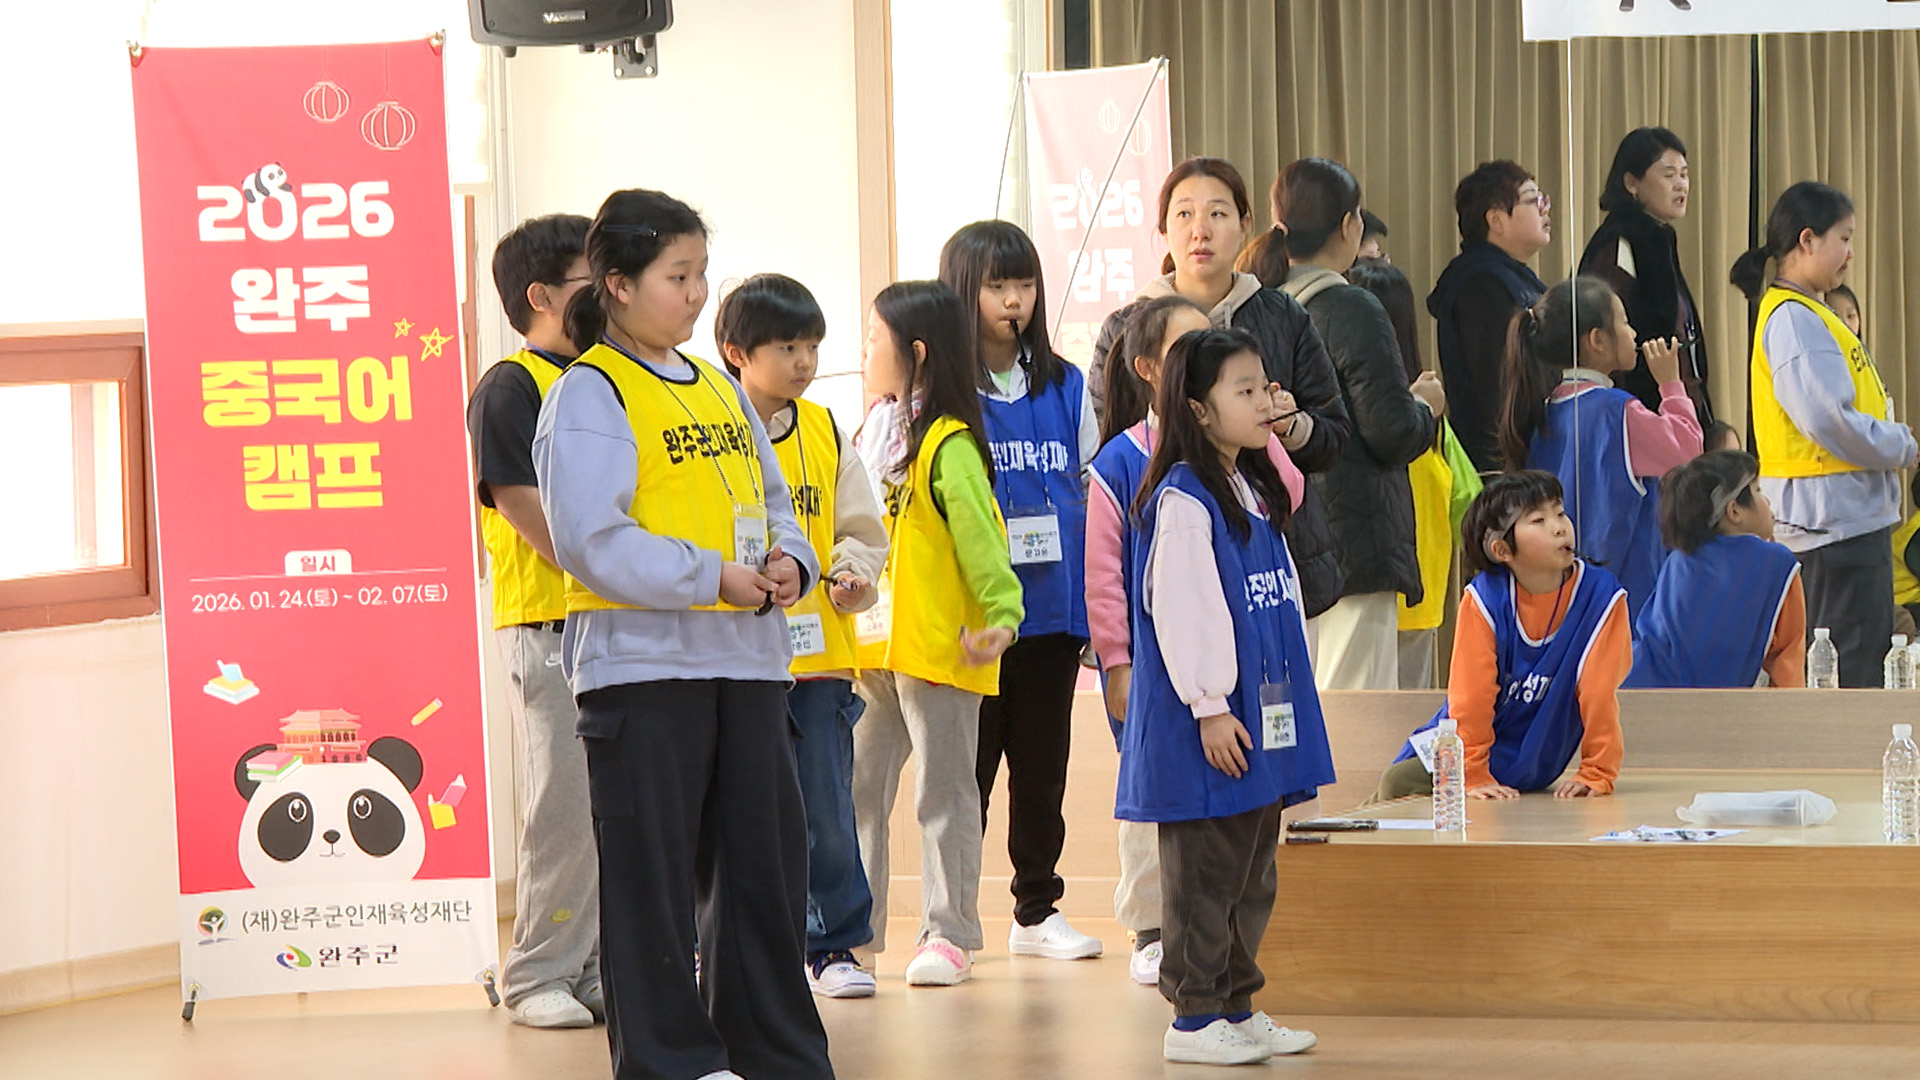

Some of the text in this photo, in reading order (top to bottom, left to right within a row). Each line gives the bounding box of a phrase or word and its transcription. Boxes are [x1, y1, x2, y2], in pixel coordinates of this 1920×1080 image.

[197, 181, 395, 243] 2026
[1051, 179, 1145, 231] 2026
[231, 265, 371, 334] 완주
[201, 356, 413, 428] 중국어
[243, 441, 384, 511] 캠프
[300, 555, 337, 573] 일시
[191, 592, 245, 612] 2026.
[250, 590, 275, 609] 01.
[279, 587, 338, 609] 24.(토)
[358, 586, 388, 605] 02.
[392, 583, 448, 604] 07.(토)
[242, 900, 473, 934] (재)완주군인재육성재단
[319, 944, 399, 968] 완주군
